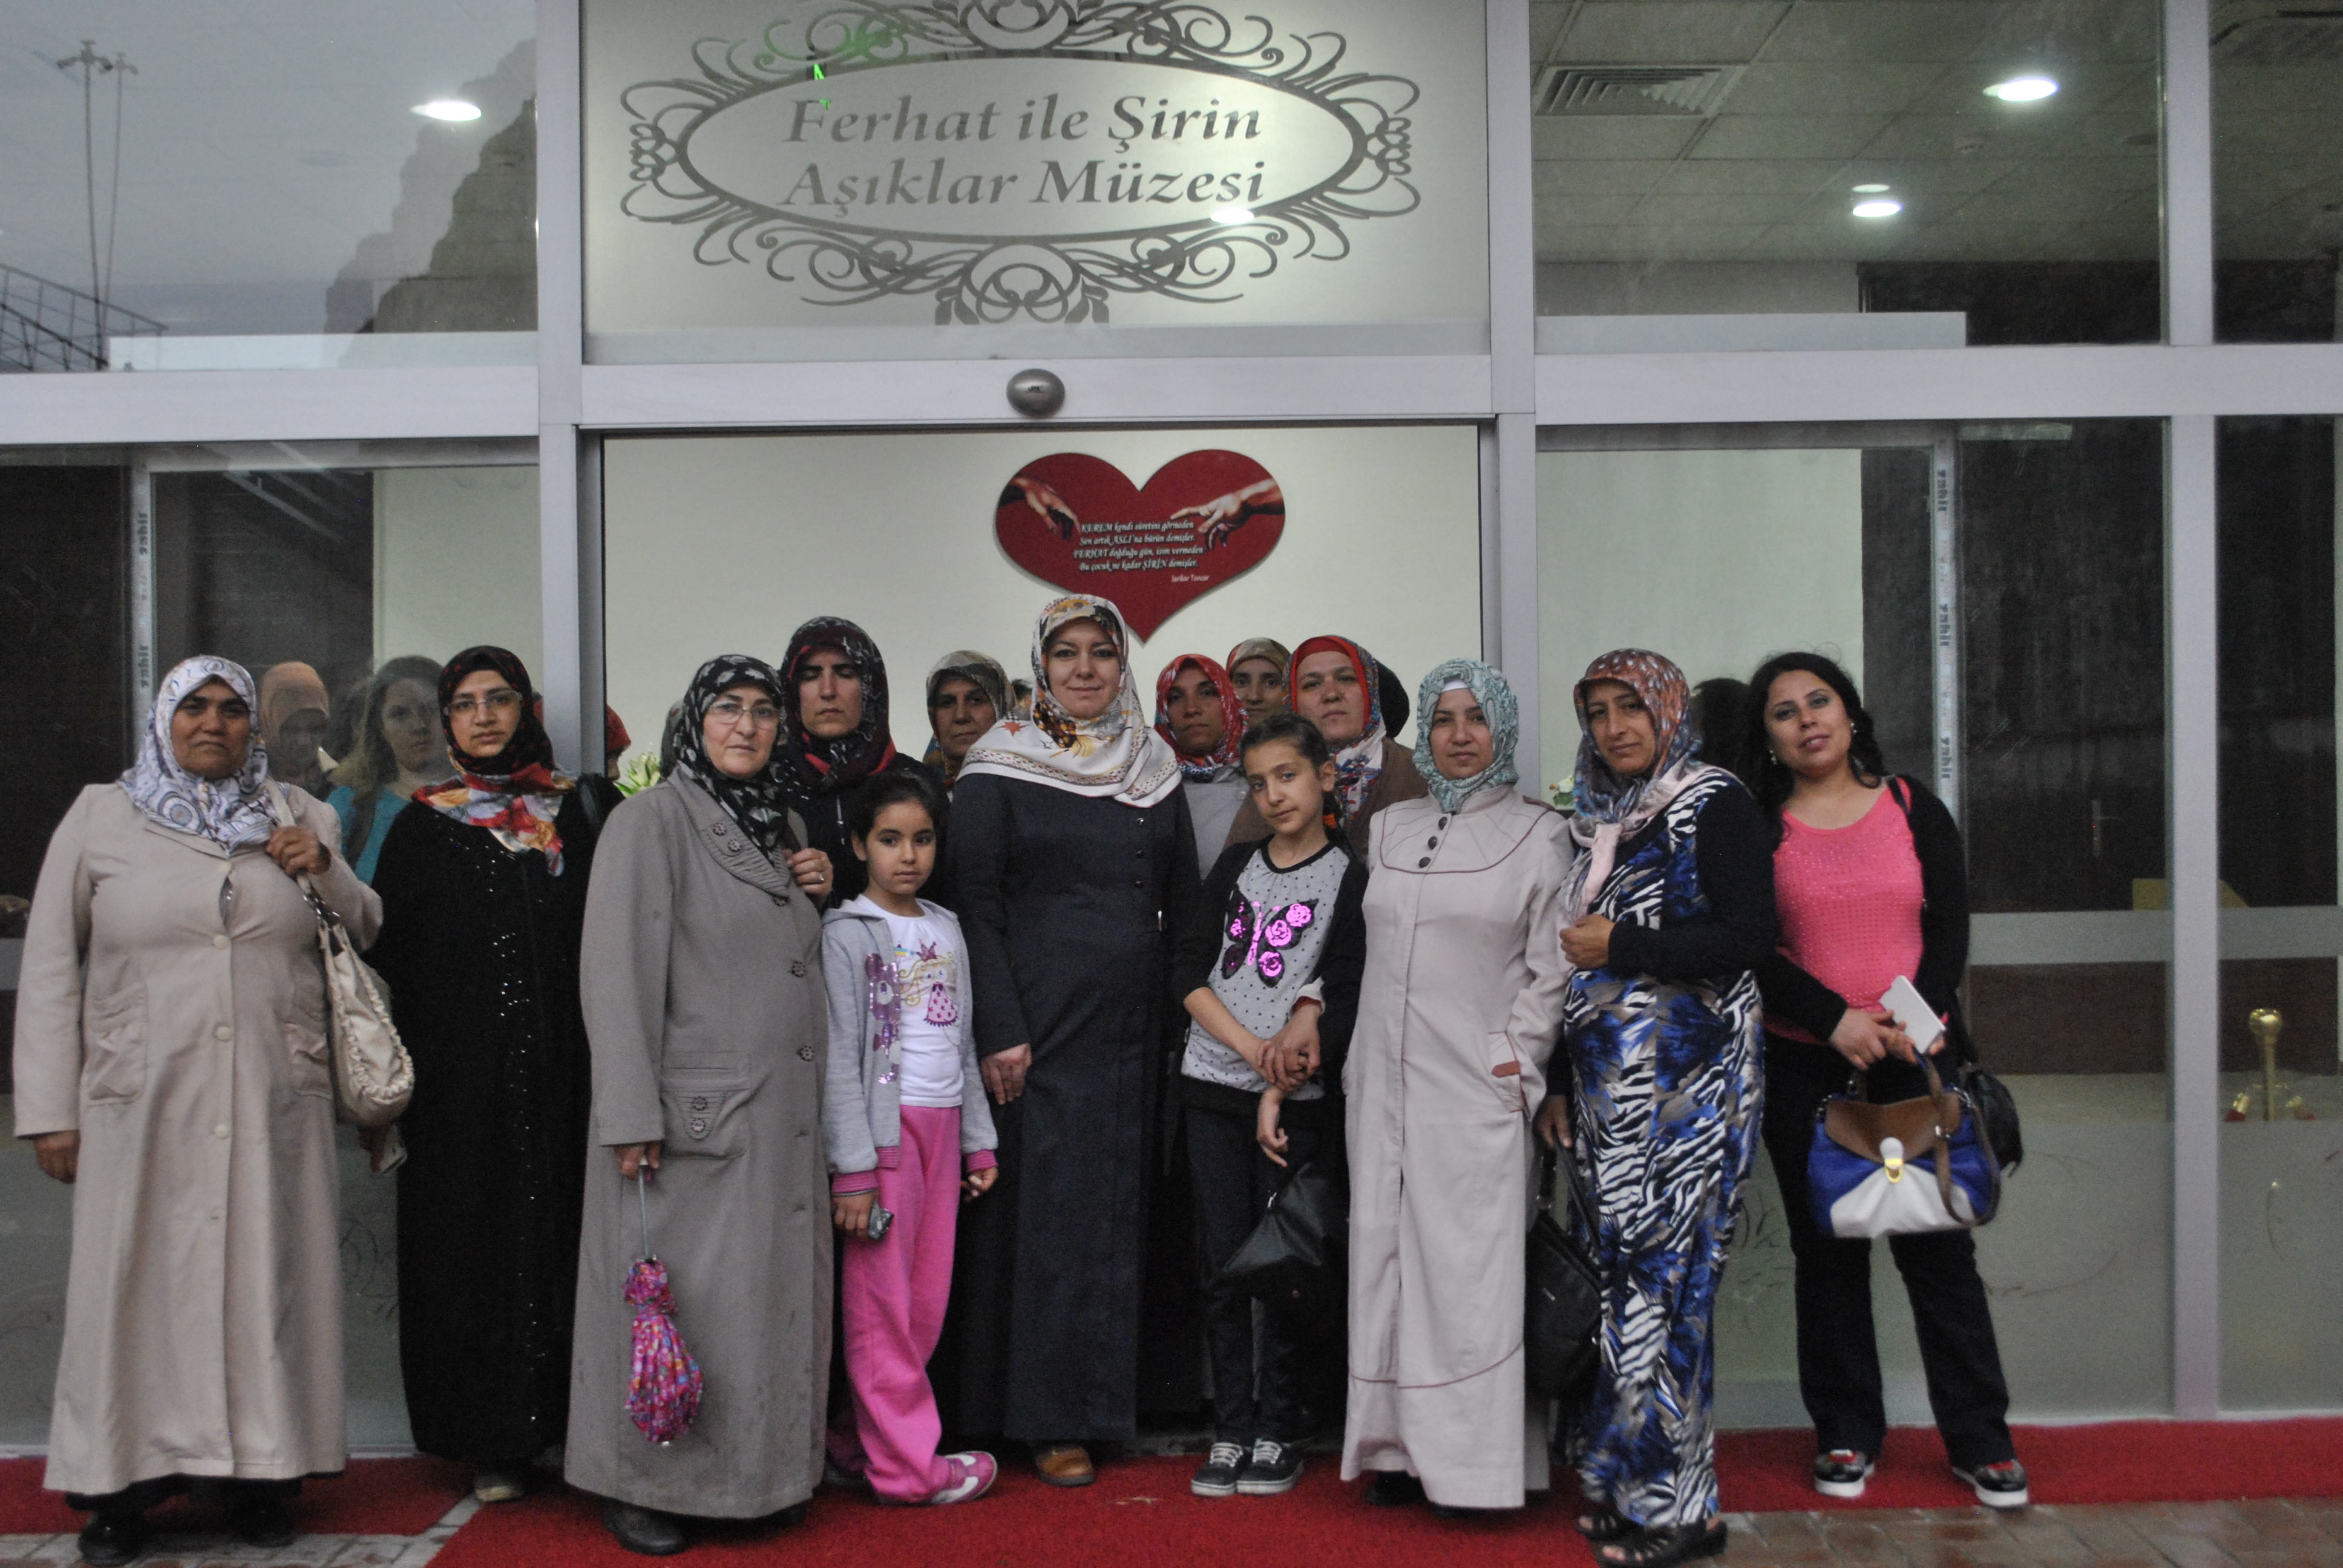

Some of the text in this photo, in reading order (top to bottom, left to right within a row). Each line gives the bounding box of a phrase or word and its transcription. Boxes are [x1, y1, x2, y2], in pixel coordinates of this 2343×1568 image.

[782, 93, 1262, 154] Ferhat ile Şirin
[776, 157, 1265, 217] Aşıklar Müzesi
[1081, 523, 1113, 533] KEREM
[1115, 521, 1133, 532] kendi
[1161, 520, 1194, 532] görmeden
[1080, 537, 1092, 546] Sen
[1144, 534, 1164, 543] bürün
[1166, 532, 1196, 543] demişler.
[1073, 549, 1109, 559] FERHAT
[1109, 547, 1138, 560] doğduğu
[1139, 547, 1154, 558] gün,
[1172, 545, 1204, 555] vermeden
[1091, 560, 1112, 572] çocuk
[1121, 560, 1142, 571] kadar
[1168, 557, 1198, 569] demişler.
